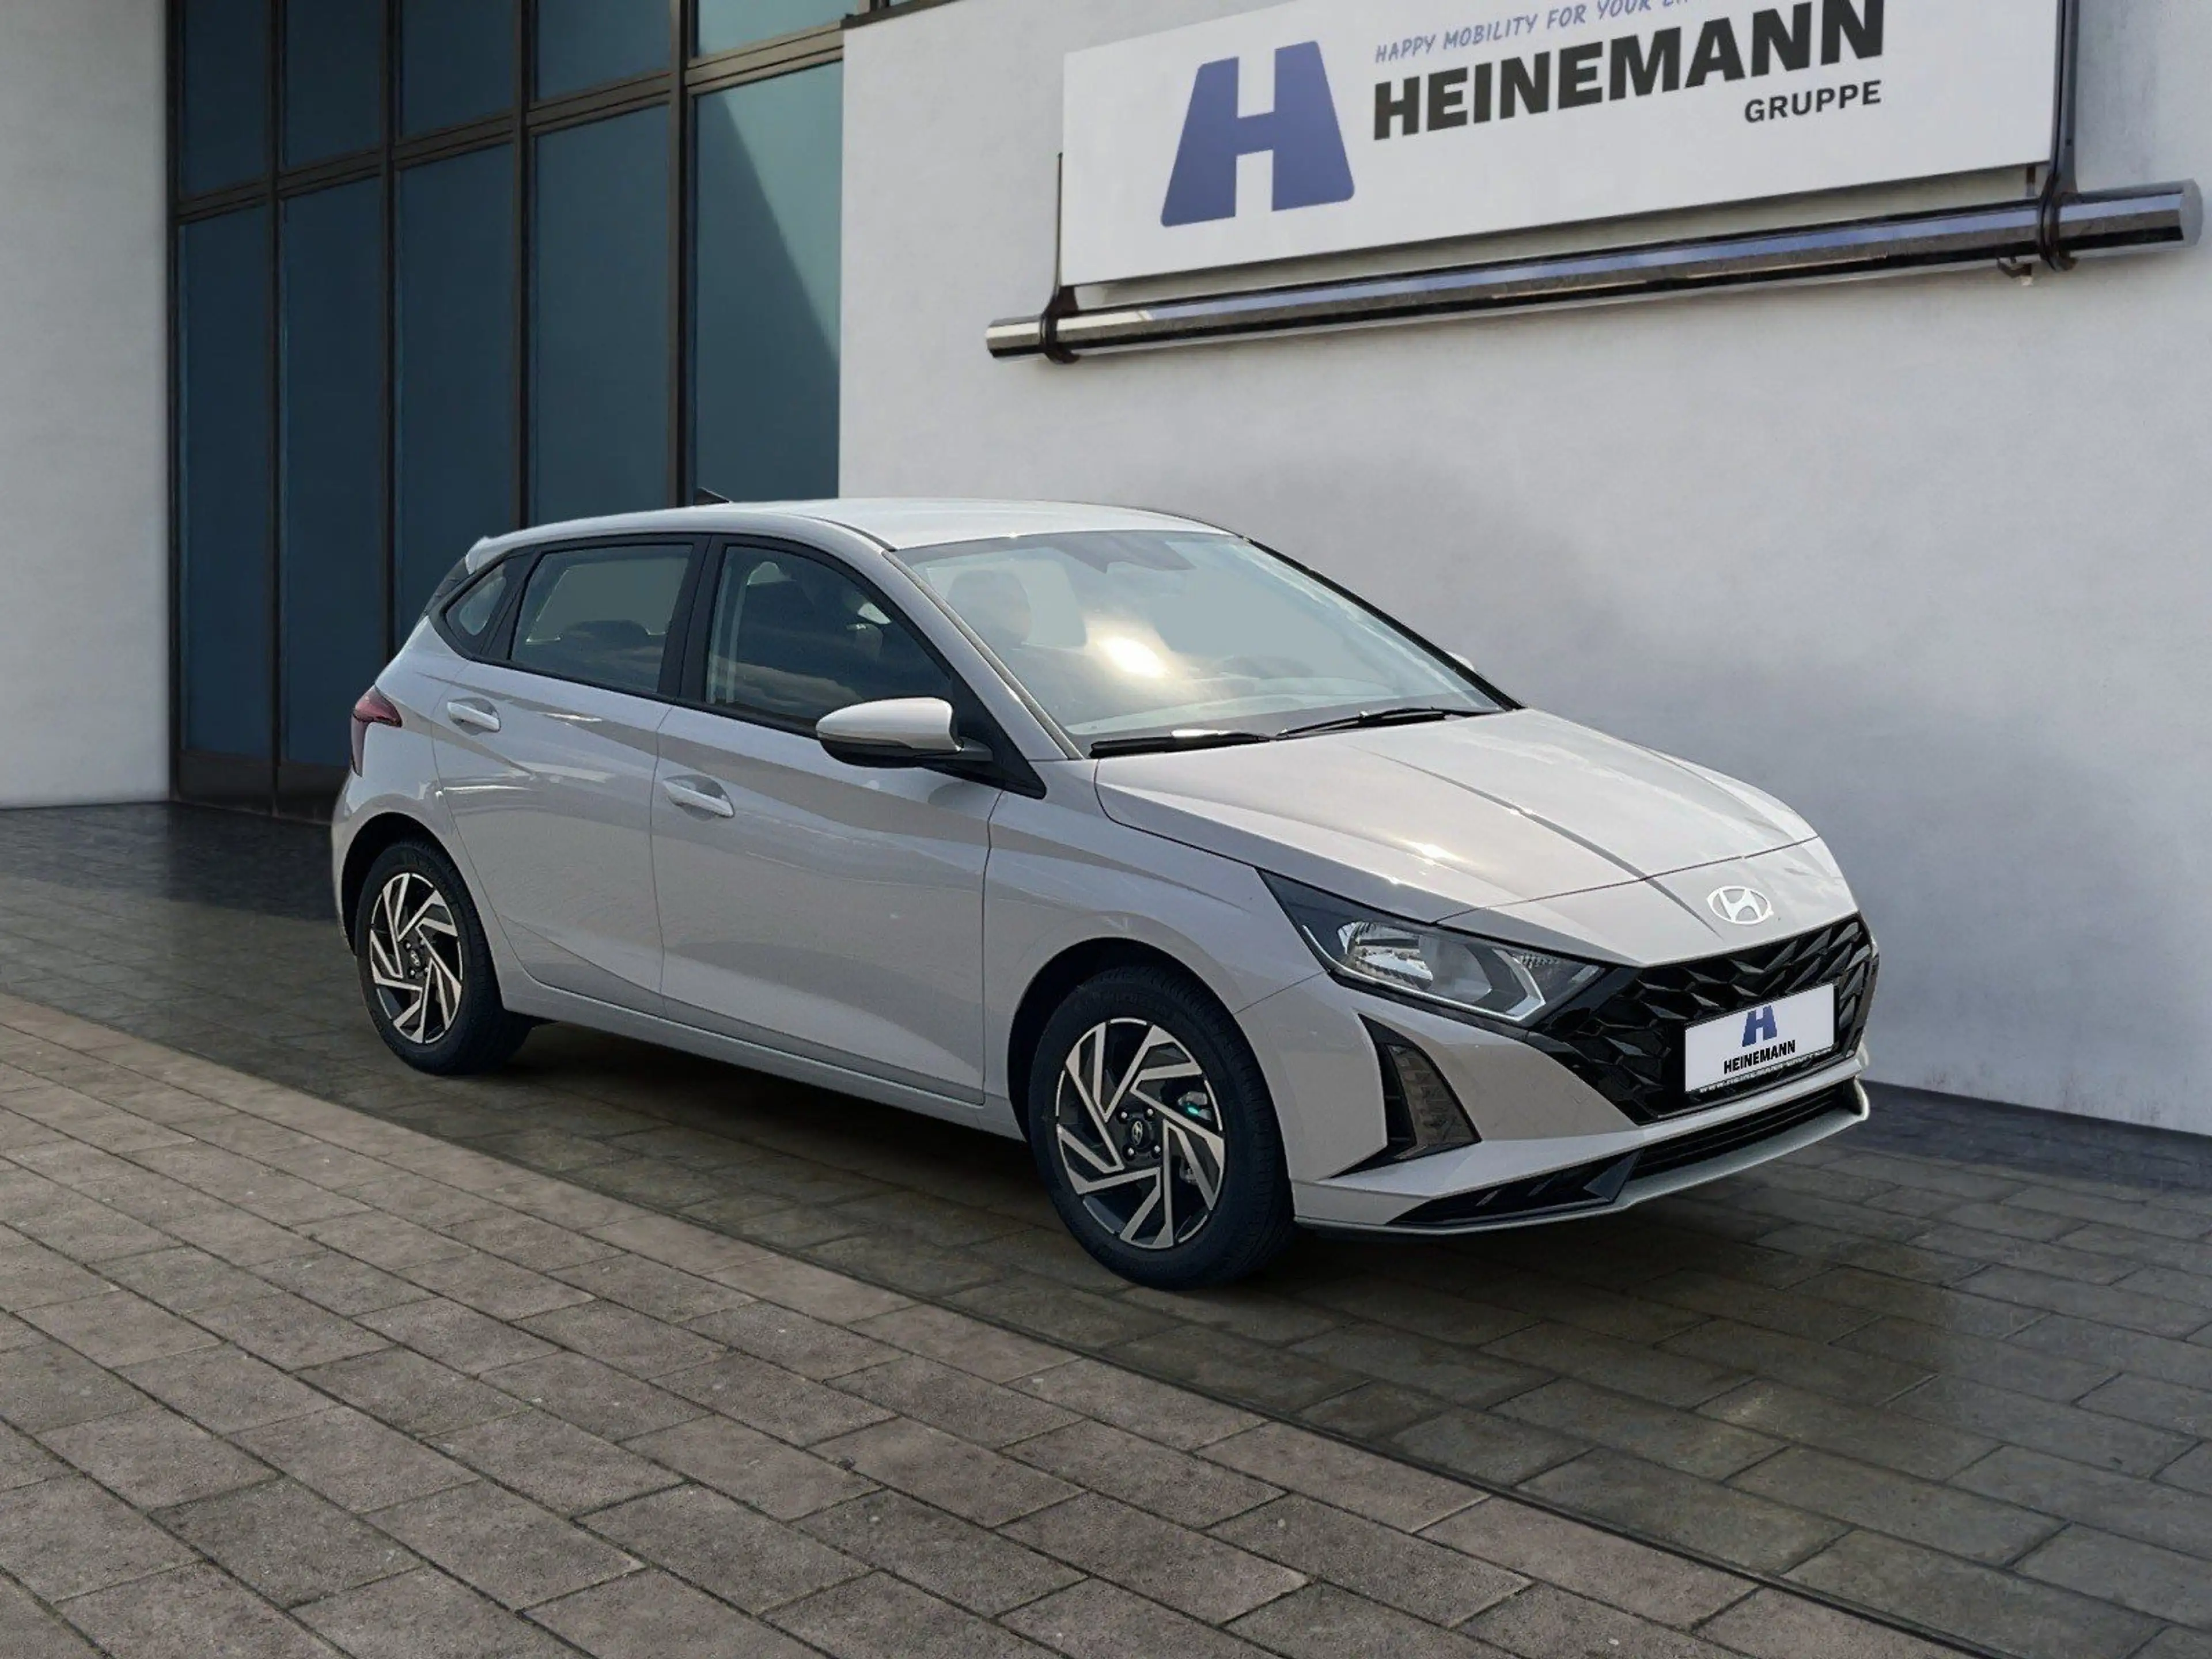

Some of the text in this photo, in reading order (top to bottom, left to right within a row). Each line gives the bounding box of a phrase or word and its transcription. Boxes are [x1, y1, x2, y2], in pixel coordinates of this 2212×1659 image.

[1375, 34, 1436, 63] HAPPY
[1444, 13, 1538, 50] MOBILITY
[1547, 4, 1587, 29] FOR
[1374, 0, 1884, 140] HEINEMANN
[1744, 79, 1881, 123] GRUPPE
[1724, 1039, 1795, 1074] HEINEMANN
